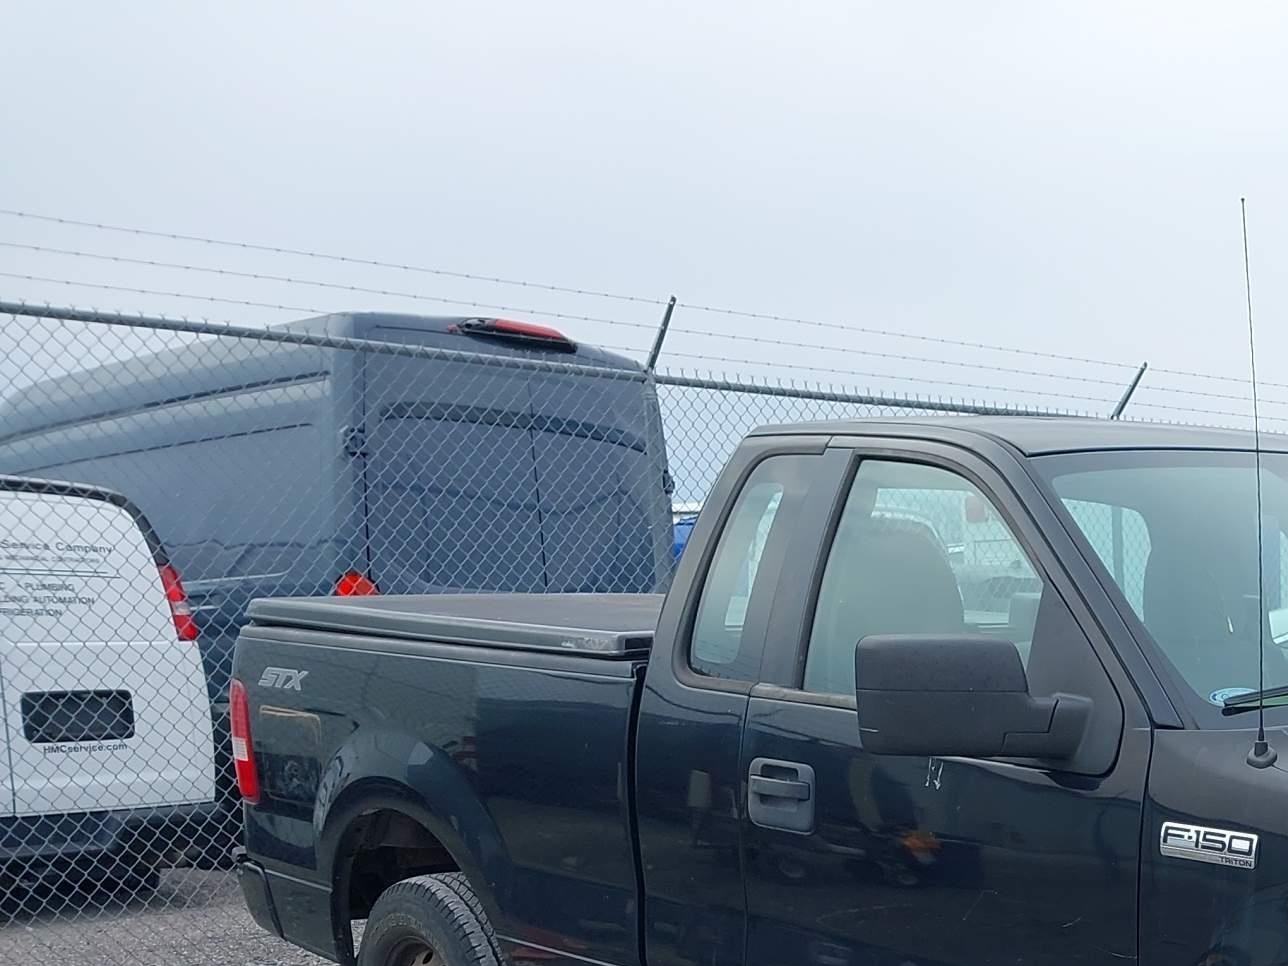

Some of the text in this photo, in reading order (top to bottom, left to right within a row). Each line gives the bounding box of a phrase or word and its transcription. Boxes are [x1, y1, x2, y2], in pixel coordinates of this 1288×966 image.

[0, 539, 112, 553] Service Company
[25, 582, 75, 592] PLUMBING
[33, 595, 95, 605] AUTOMATION
[257, 666, 309, 691] STX
[43, 743, 128, 754] HMCservice.com
[1219, 856, 1252, 868] TRITON
